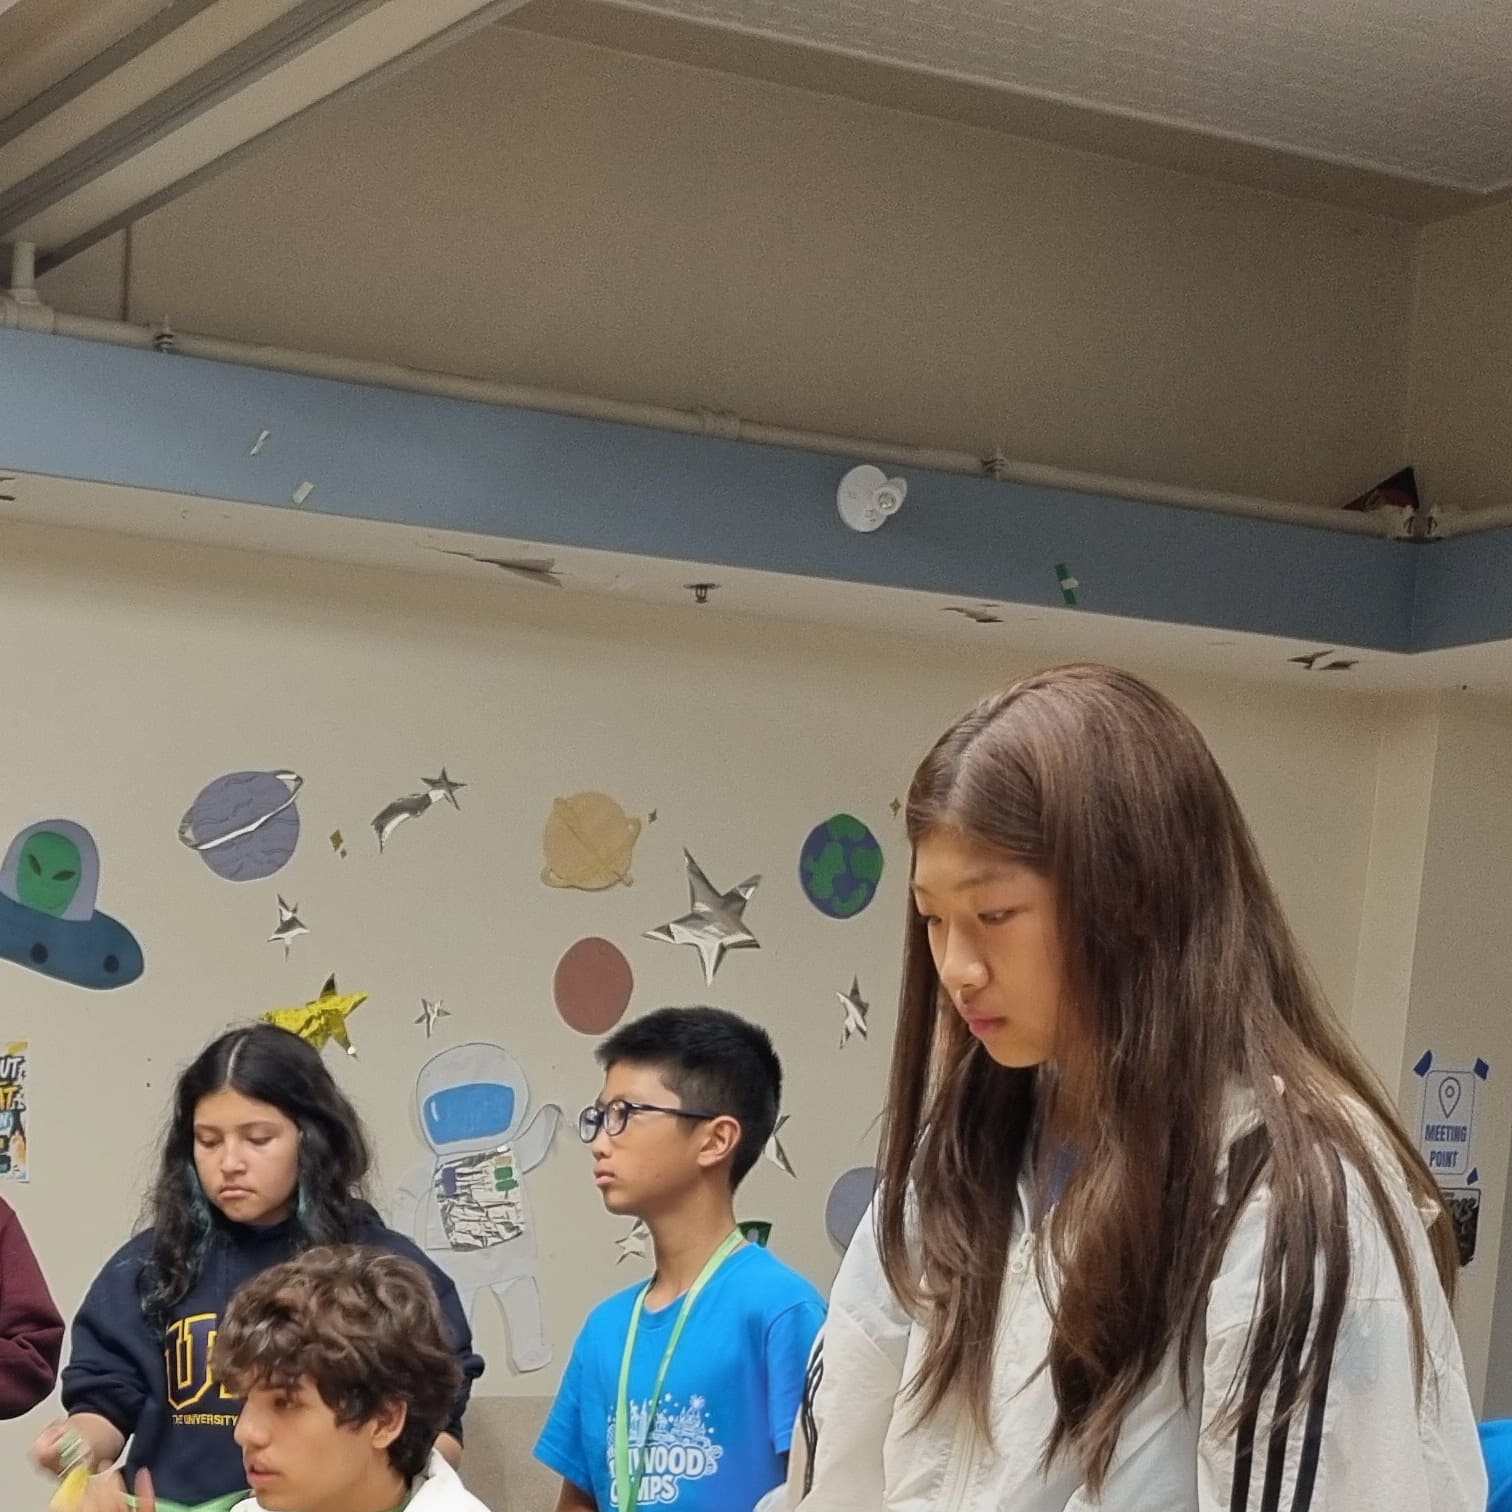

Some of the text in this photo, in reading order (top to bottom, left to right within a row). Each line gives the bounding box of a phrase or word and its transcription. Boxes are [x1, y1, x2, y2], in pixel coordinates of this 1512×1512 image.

[1425, 1125, 1468, 1142] MEETING
[1429, 1151, 1458, 1168] POINT
[184, 1413, 239, 1427] UNIVERSITY
[610, 1474, 676, 1503] CMPS
